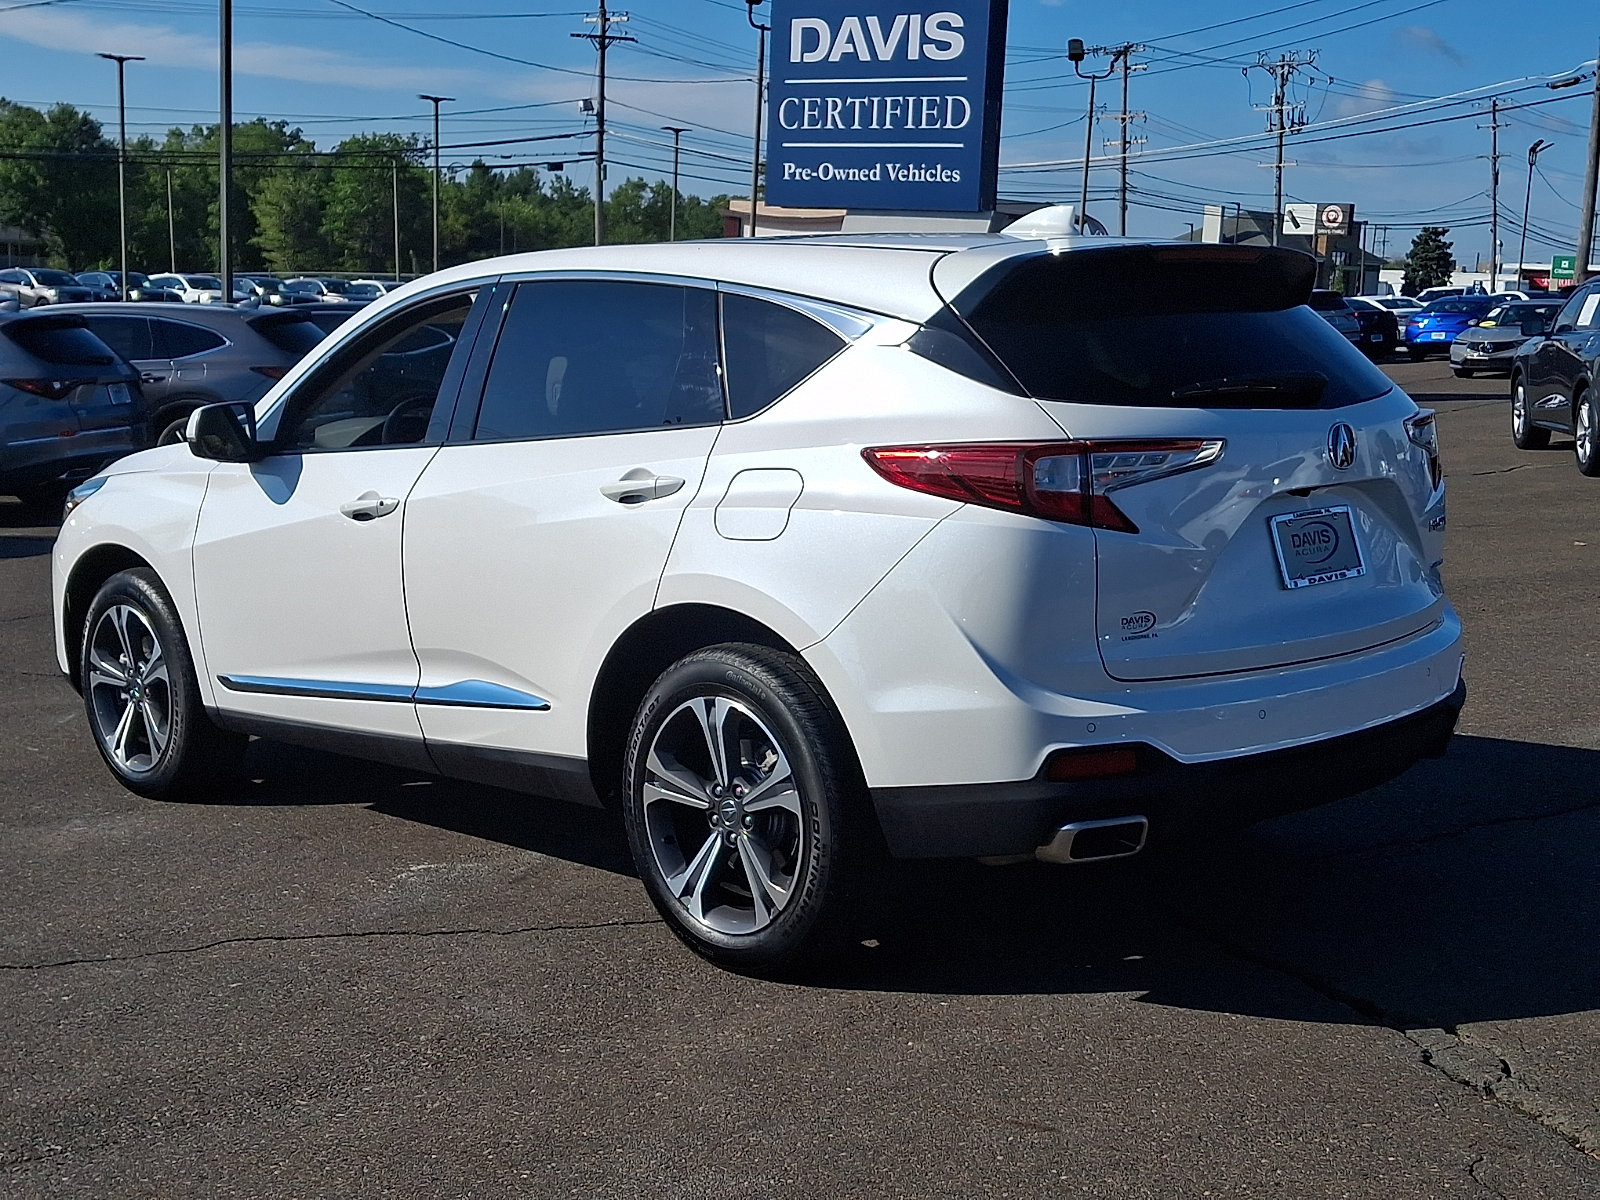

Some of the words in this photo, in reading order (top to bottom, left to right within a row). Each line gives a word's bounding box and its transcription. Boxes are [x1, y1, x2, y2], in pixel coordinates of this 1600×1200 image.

[789, 12, 965, 63] DAVIS
[778, 95, 971, 130] CERTIFIED
[782, 162, 881, 181] Pre-Owned
[885, 163, 961, 183] Vehicles
[1291, 529, 1331, 549] DAVIS
[1295, 545, 1330, 557] ACURA
[1307, 571, 1348, 585] DAVIS
[1121, 615, 1151, 626] DAVIS
